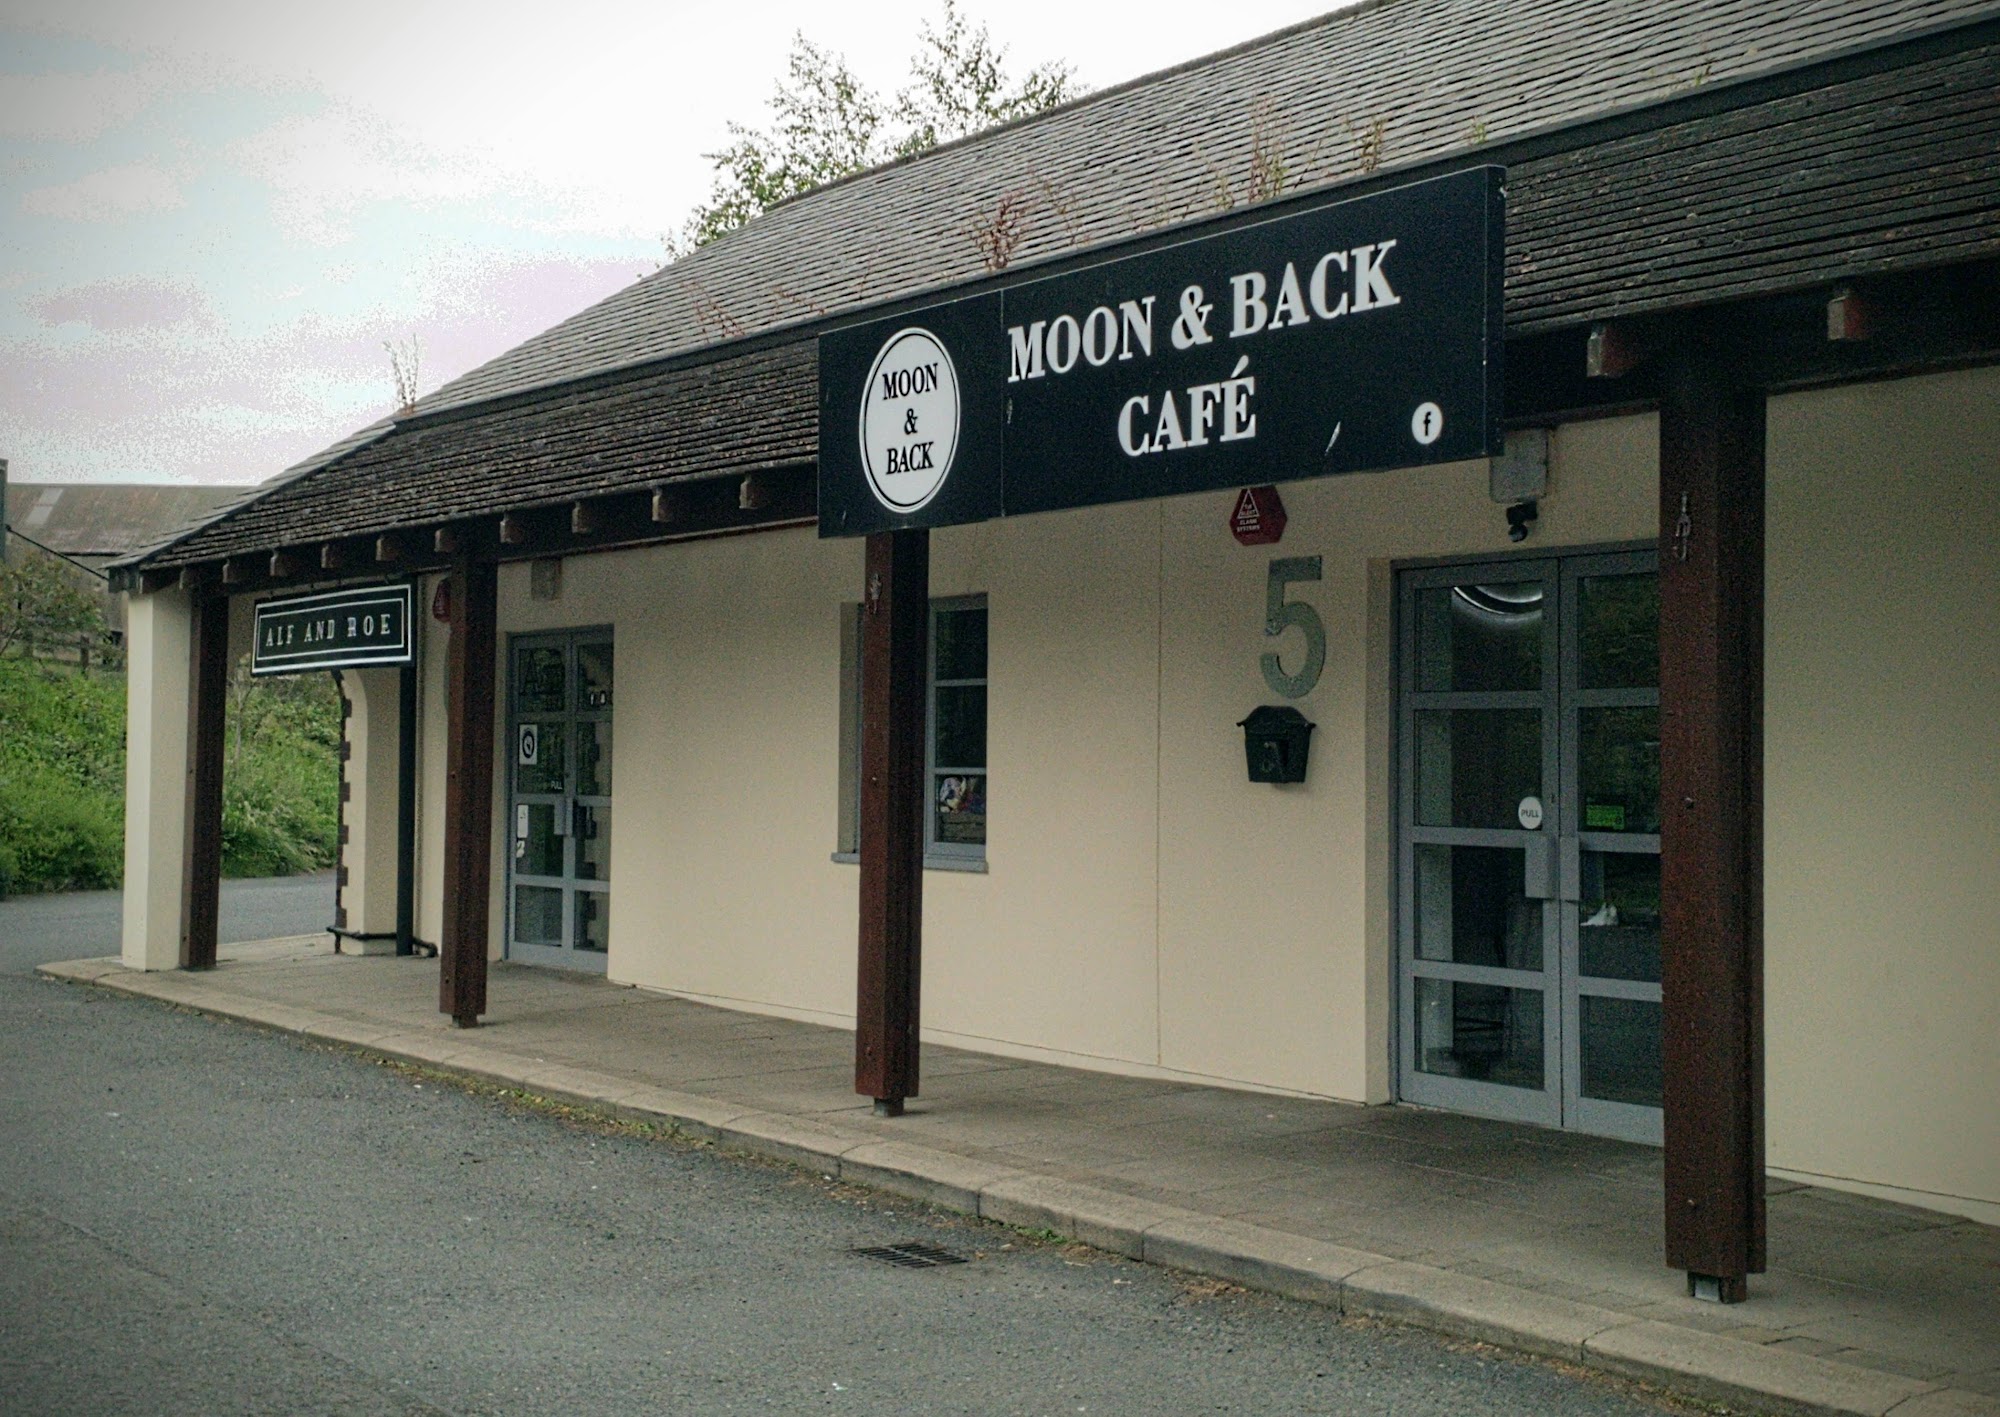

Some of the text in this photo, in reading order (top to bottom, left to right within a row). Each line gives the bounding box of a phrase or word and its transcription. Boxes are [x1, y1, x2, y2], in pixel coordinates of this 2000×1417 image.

[1007, 238, 1401, 384] MOON & BACK
[882, 362, 938, 400] MOON
[903, 408, 918, 435] &
[1117, 354, 1256, 457] CAFÉ
[885, 441, 934, 475] BACK
[265, 613, 392, 647] ALF AND ROE
[1260, 555, 1326, 699] 5
[1520, 808, 1540, 818] PULL
